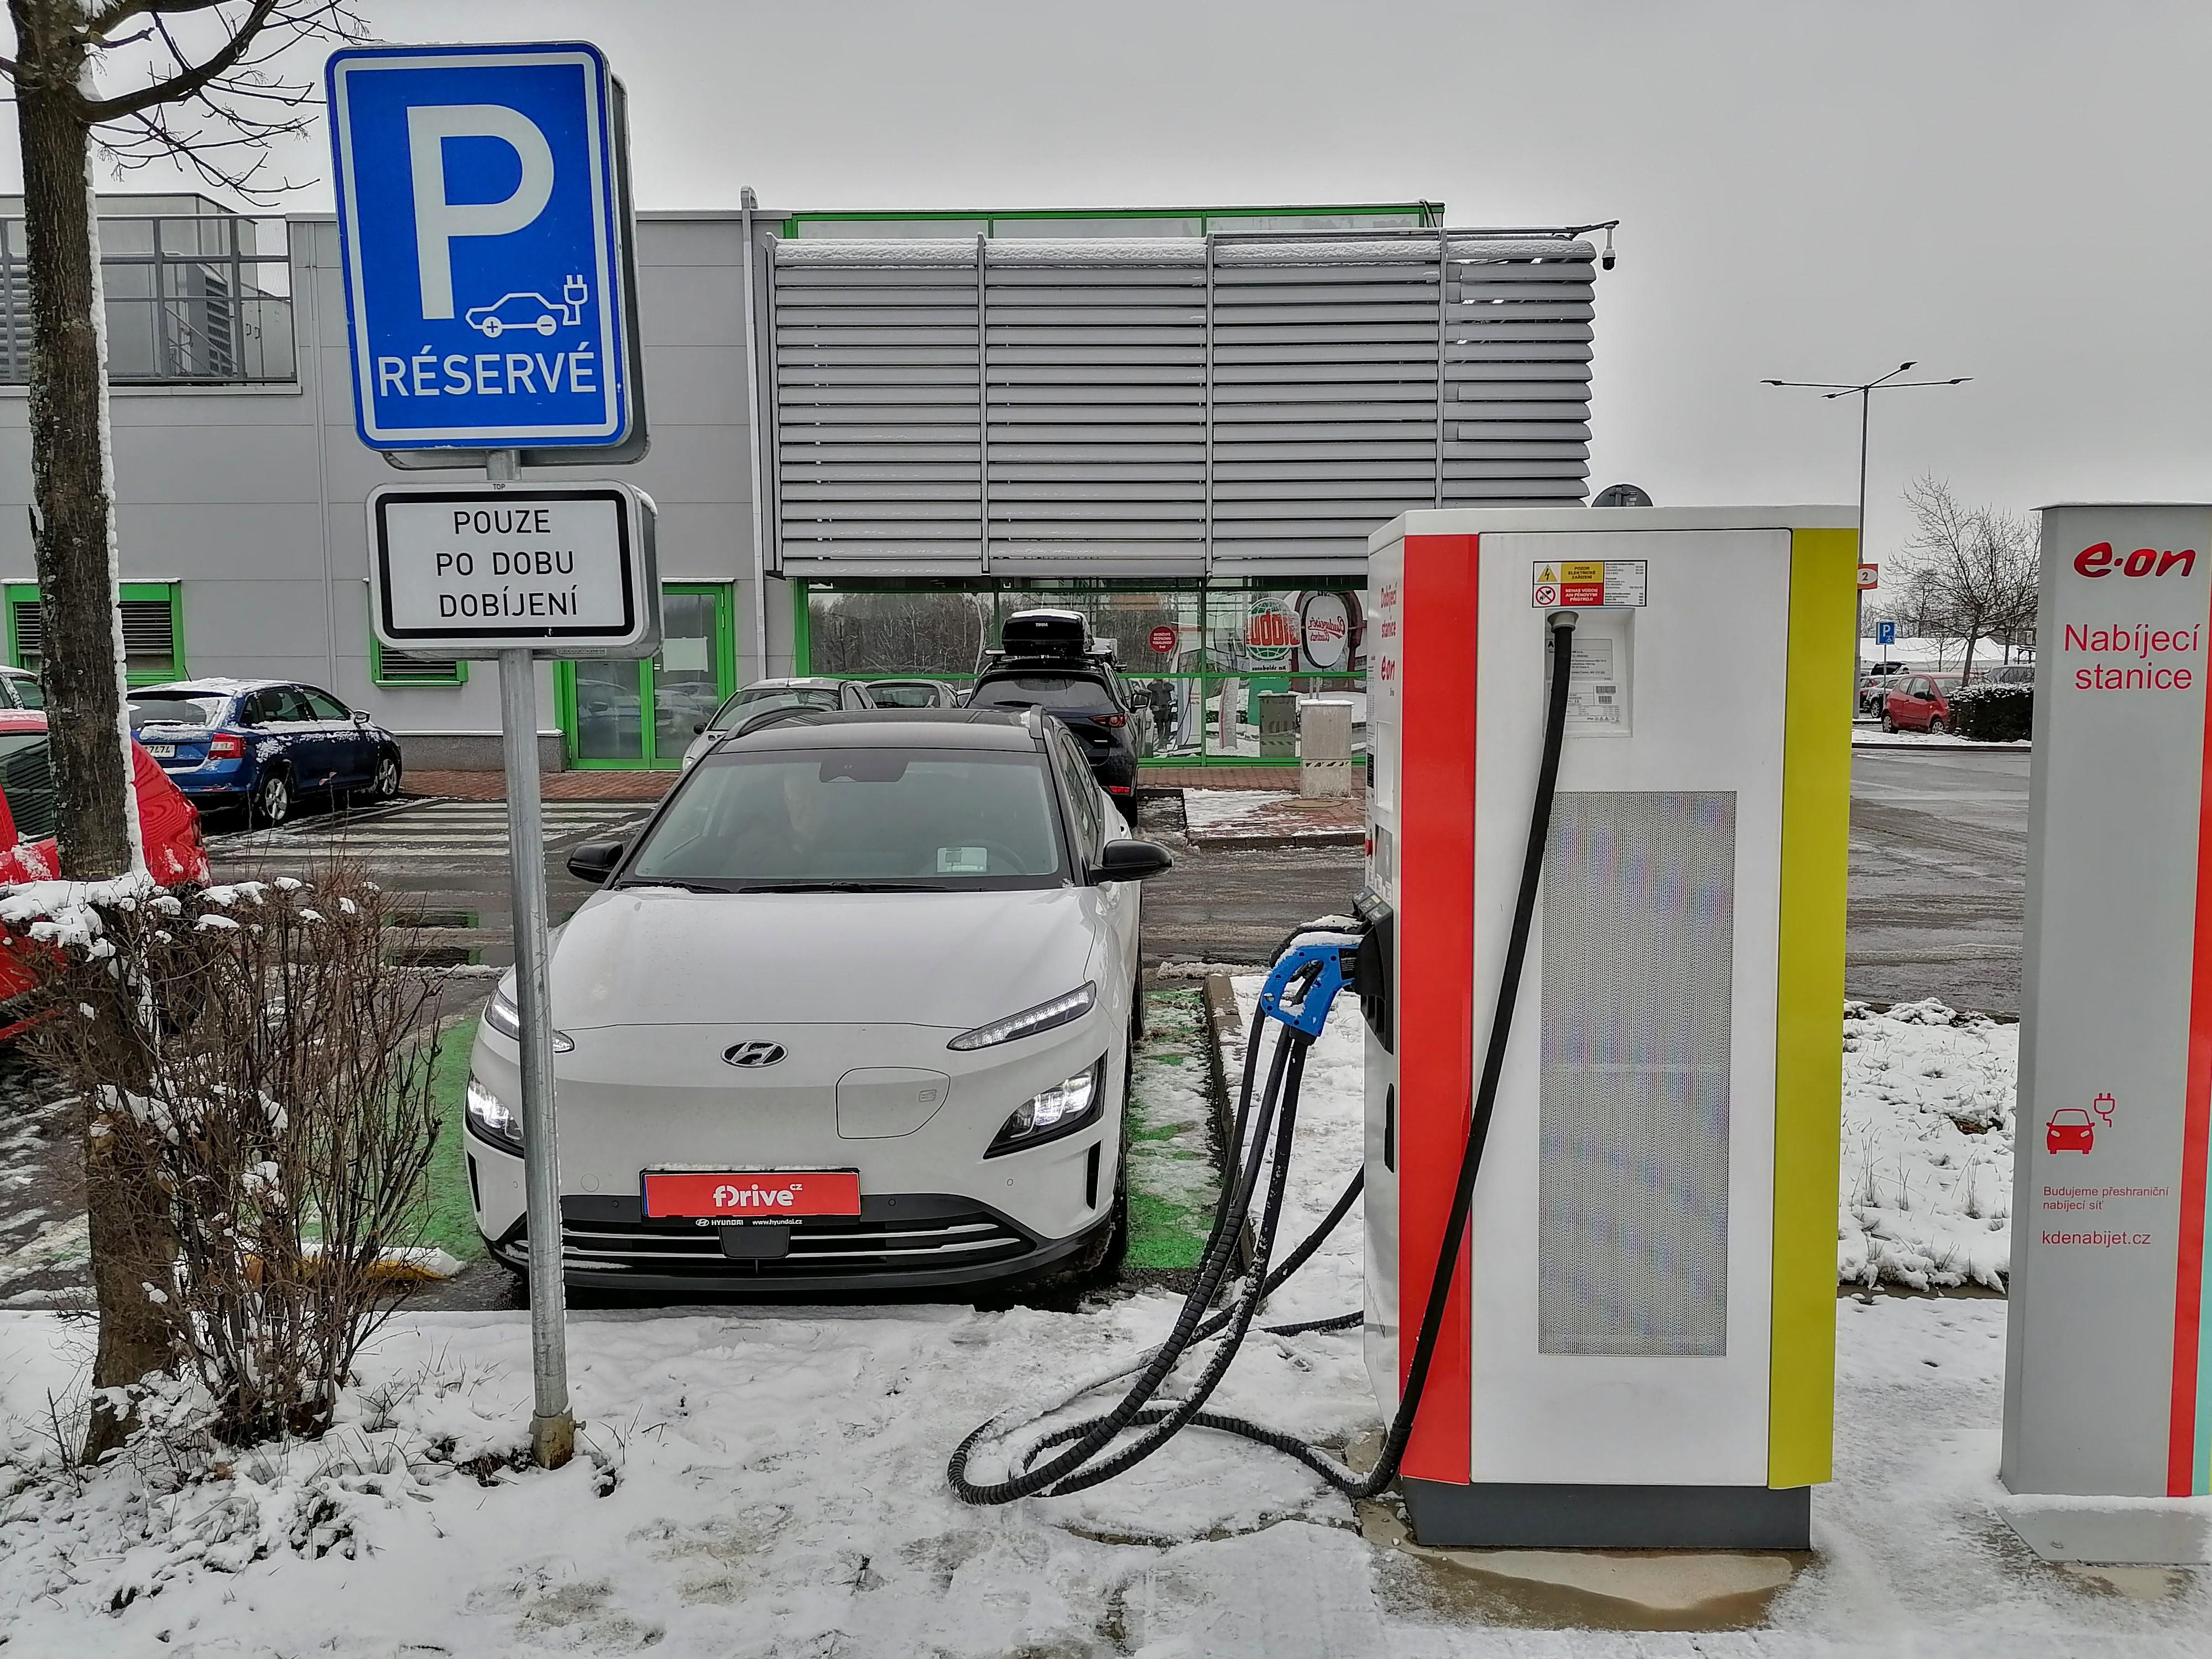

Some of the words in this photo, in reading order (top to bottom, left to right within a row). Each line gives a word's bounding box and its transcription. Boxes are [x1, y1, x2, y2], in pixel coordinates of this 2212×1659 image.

[406, 104, 554, 320] P
[378, 341, 597, 397] RÉSERVÉ
[453, 509, 551, 535] POUZE
[436, 552, 473, 576] PO
[492, 551, 574, 576] DOBU
[1861, 572, 1869, 581] 2
[439, 584, 577, 617] DOBÍJENÍ
[1882, 624, 1891, 637] P
[2064, 624, 2201, 659] Nabíjecí
[2075, 662, 2192, 690] stanice
[2043, 1187, 2098, 1198] Budujeme
[2102, 1186, 2169, 1198] přeshraniční
[2043, 1201, 2086, 1212] nabíjecí
[2089, 1201, 2104, 1210] síť
[2042, 1230, 2151, 1248] kdenabijet.cz
